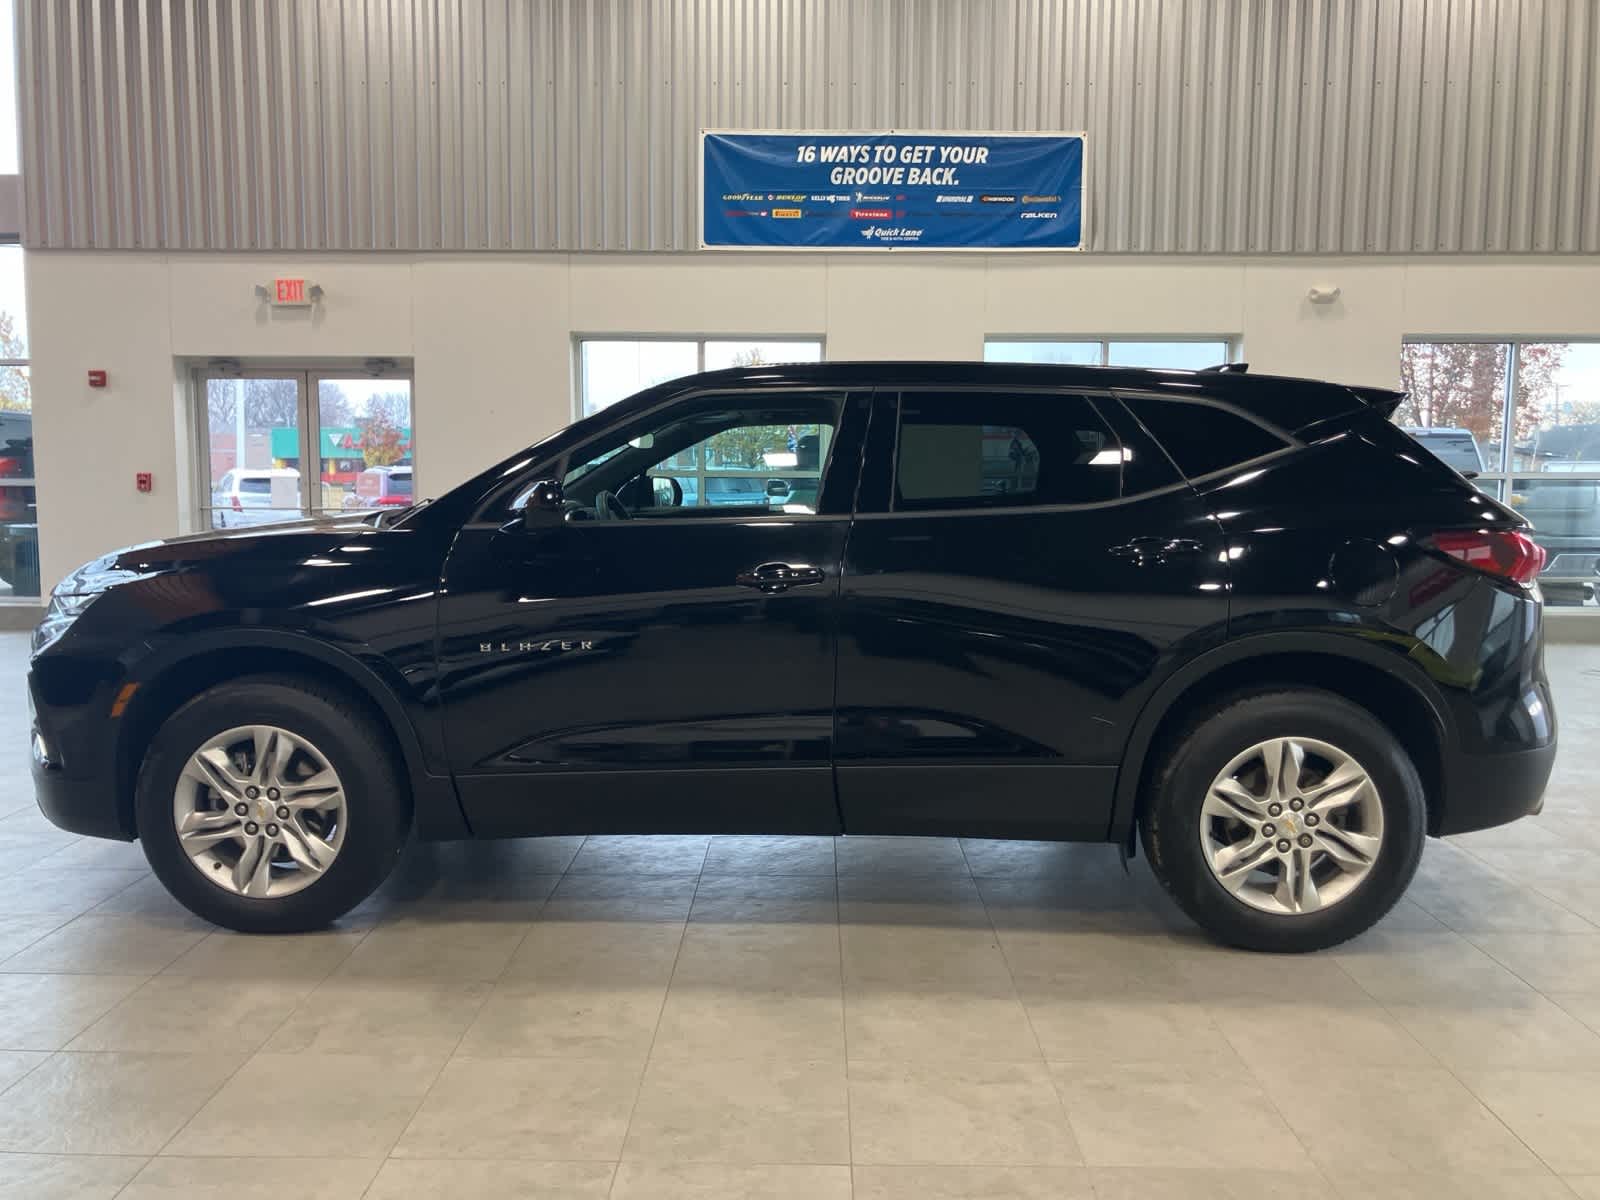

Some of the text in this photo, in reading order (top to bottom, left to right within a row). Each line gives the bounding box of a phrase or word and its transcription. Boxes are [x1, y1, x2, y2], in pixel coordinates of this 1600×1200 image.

[797, 146, 989, 164] 16 WAYS TO GET YOUR
[830, 167, 960, 185] GROOVE BACK.
[874, 228, 923, 237] Quick Lane
[276, 279, 305, 302] EXIT
[479, 640, 592, 652] BLAZER
